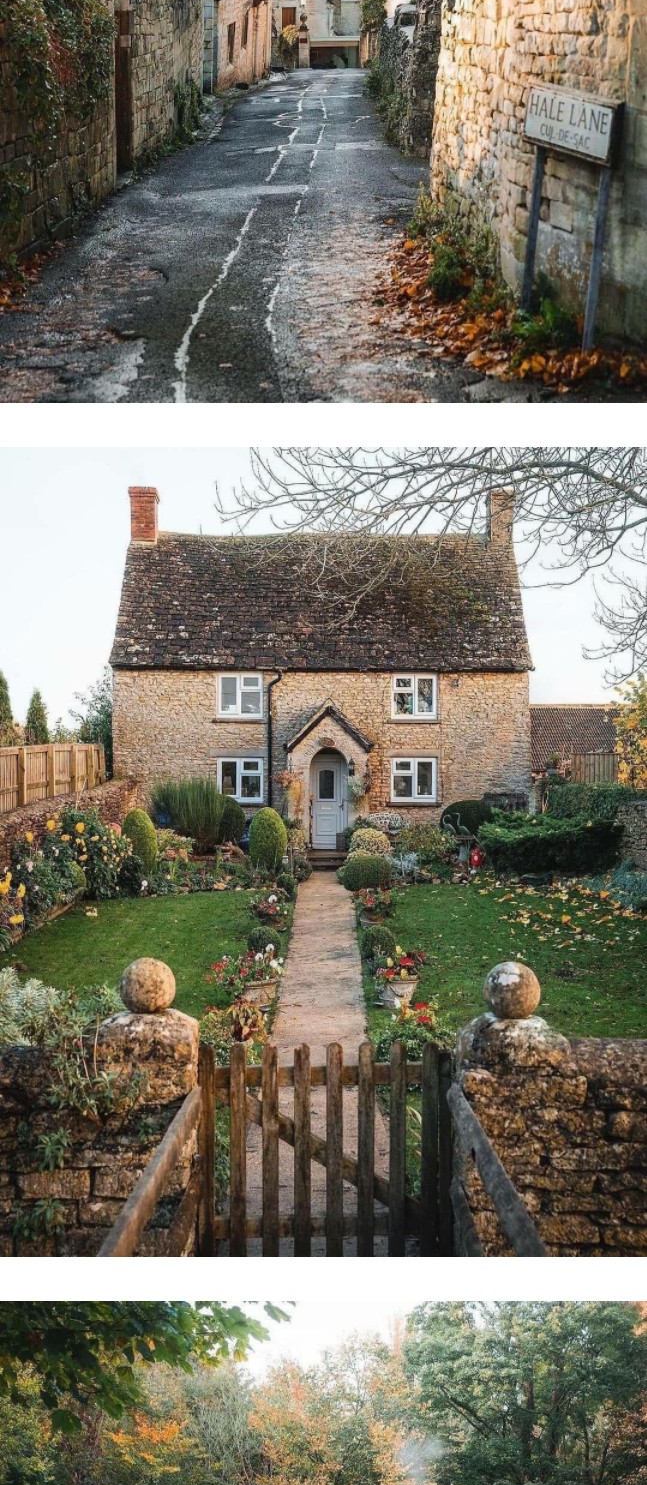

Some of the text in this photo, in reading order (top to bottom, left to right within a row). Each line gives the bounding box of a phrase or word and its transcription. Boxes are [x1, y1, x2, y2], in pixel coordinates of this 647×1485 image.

[529, 93, 609, 135] HALE LANE
[540, 123, 591, 150] CUL-DE-SAC
